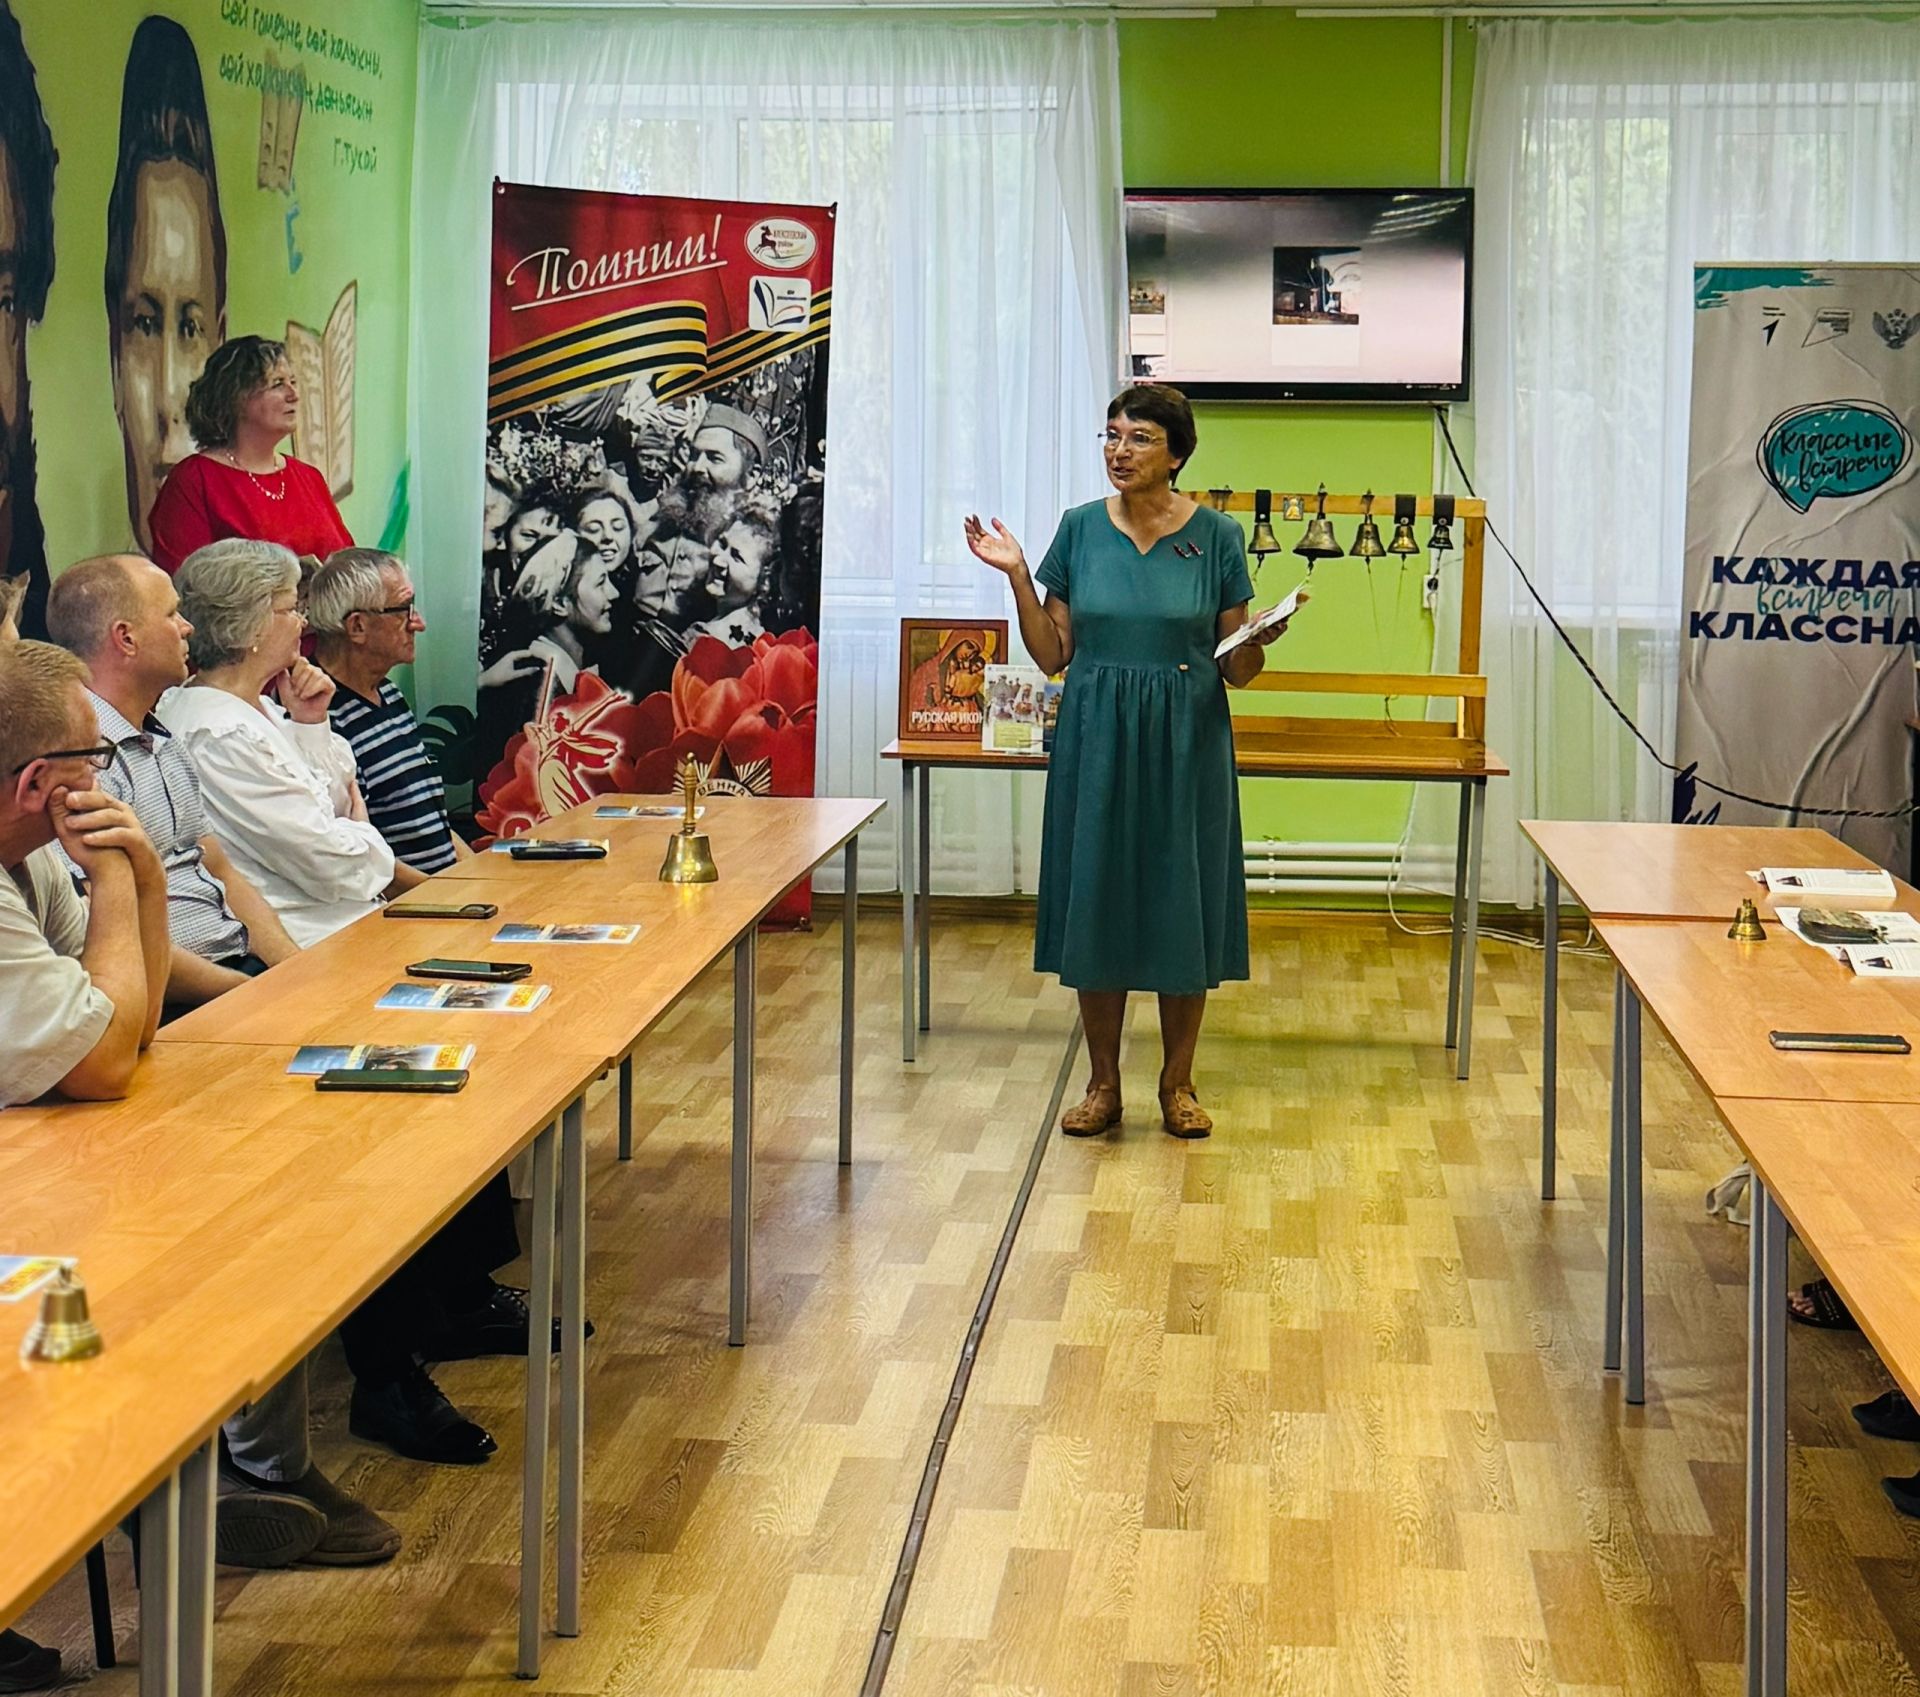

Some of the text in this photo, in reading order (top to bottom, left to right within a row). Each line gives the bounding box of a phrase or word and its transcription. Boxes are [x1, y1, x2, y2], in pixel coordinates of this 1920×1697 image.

[506, 213, 722, 299] Помним!
[1798, 449, 1900, 492] встречи
[1712, 556, 1920, 592] КАЖДАЯ
[1757, 557, 1899, 622] встреча
[911, 711, 957, 724] РУССКАЯ
